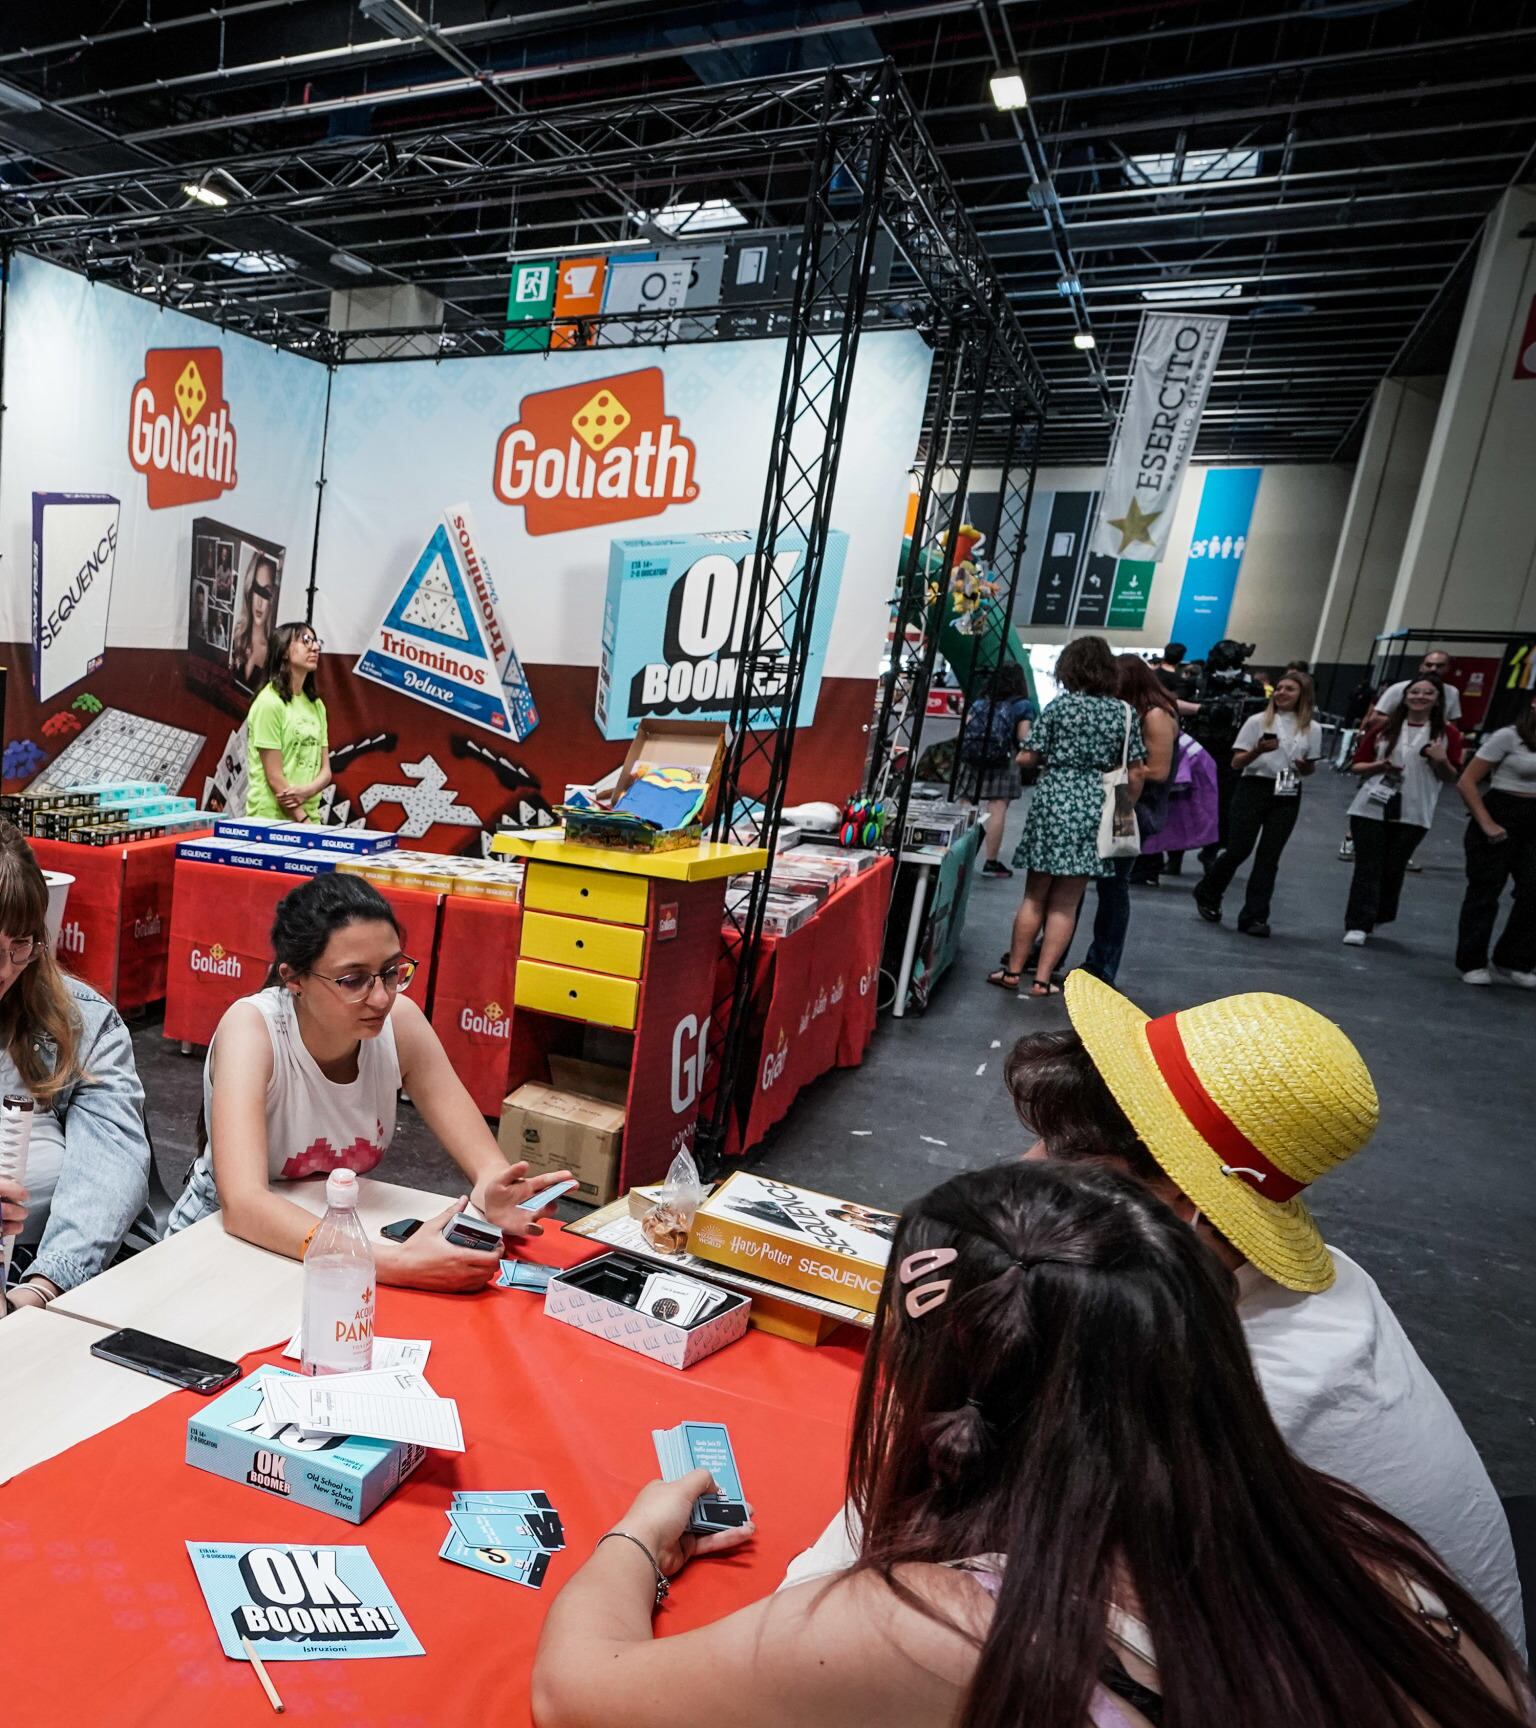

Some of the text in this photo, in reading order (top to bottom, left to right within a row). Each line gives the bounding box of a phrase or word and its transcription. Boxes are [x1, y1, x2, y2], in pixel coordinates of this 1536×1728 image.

[1136, 326, 1200, 492] ESERCITO
[132, 387, 234, 484] Goliath
[500, 424, 689, 500] Goliath
[40, 523, 118, 650] SEQUENCE
[454, 515, 507, 662] Triominos
[381, 630, 485, 685] Triominos
[403, 670, 454, 703] Deluxe
[642, 655, 801, 704] BOOM
[218, 826, 250, 838] SEQUENCE
[269, 833, 301, 844] SEQUENCE
[321, 839, 355, 851] SEQUENCE
[180, 848, 212, 860] SEQUENCE
[230, 855, 263, 867] SEQUENCE
[284, 862, 318, 874] SEQUENCE
[191, 949, 241, 978] Goliath
[461, 1008, 510, 1039] Goliat
[757, 1179, 858, 1256] SEQUENCE
[730, 1236, 884, 1294] Harry Potter SEQUENC
[355, 1306, 375, 1320] ACQU
[335, 1319, 375, 1342] PANN
[256, 1451, 287, 1481] OK
[250, 1471, 292, 1494] BOOMER
[306, 1473, 354, 1494] Old School vs.
[313, 1483, 354, 1503] New School
[333, 1499, 353, 1511] Trivia
[247, 1548, 363, 1605] OK
[241, 1605, 398, 1634] BOOMER!
[303, 1645, 347, 1653] Istruzioni
